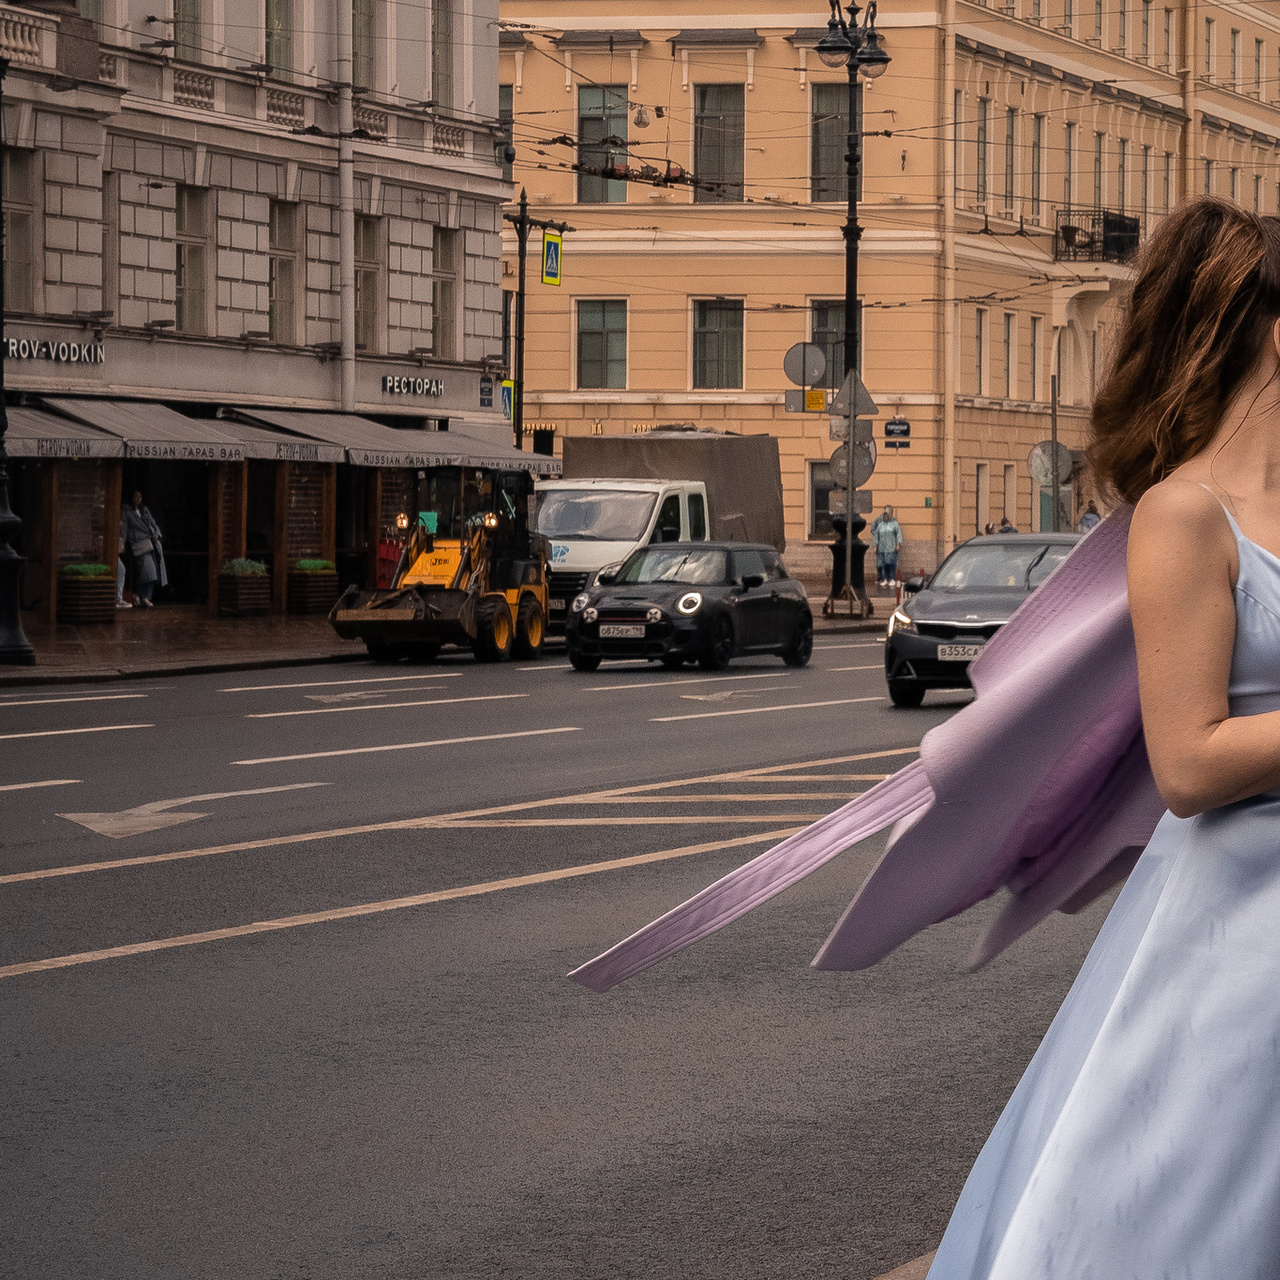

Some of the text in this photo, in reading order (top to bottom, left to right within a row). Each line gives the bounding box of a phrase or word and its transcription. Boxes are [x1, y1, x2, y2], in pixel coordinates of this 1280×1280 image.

[386, 376, 444, 396] РЕСТОРАН
[129, 445, 242, 459] RUSSIAN TAPAS BAR
[363, 454, 400, 465] RUSSIAN
[405, 456, 430, 466] TAPAS
